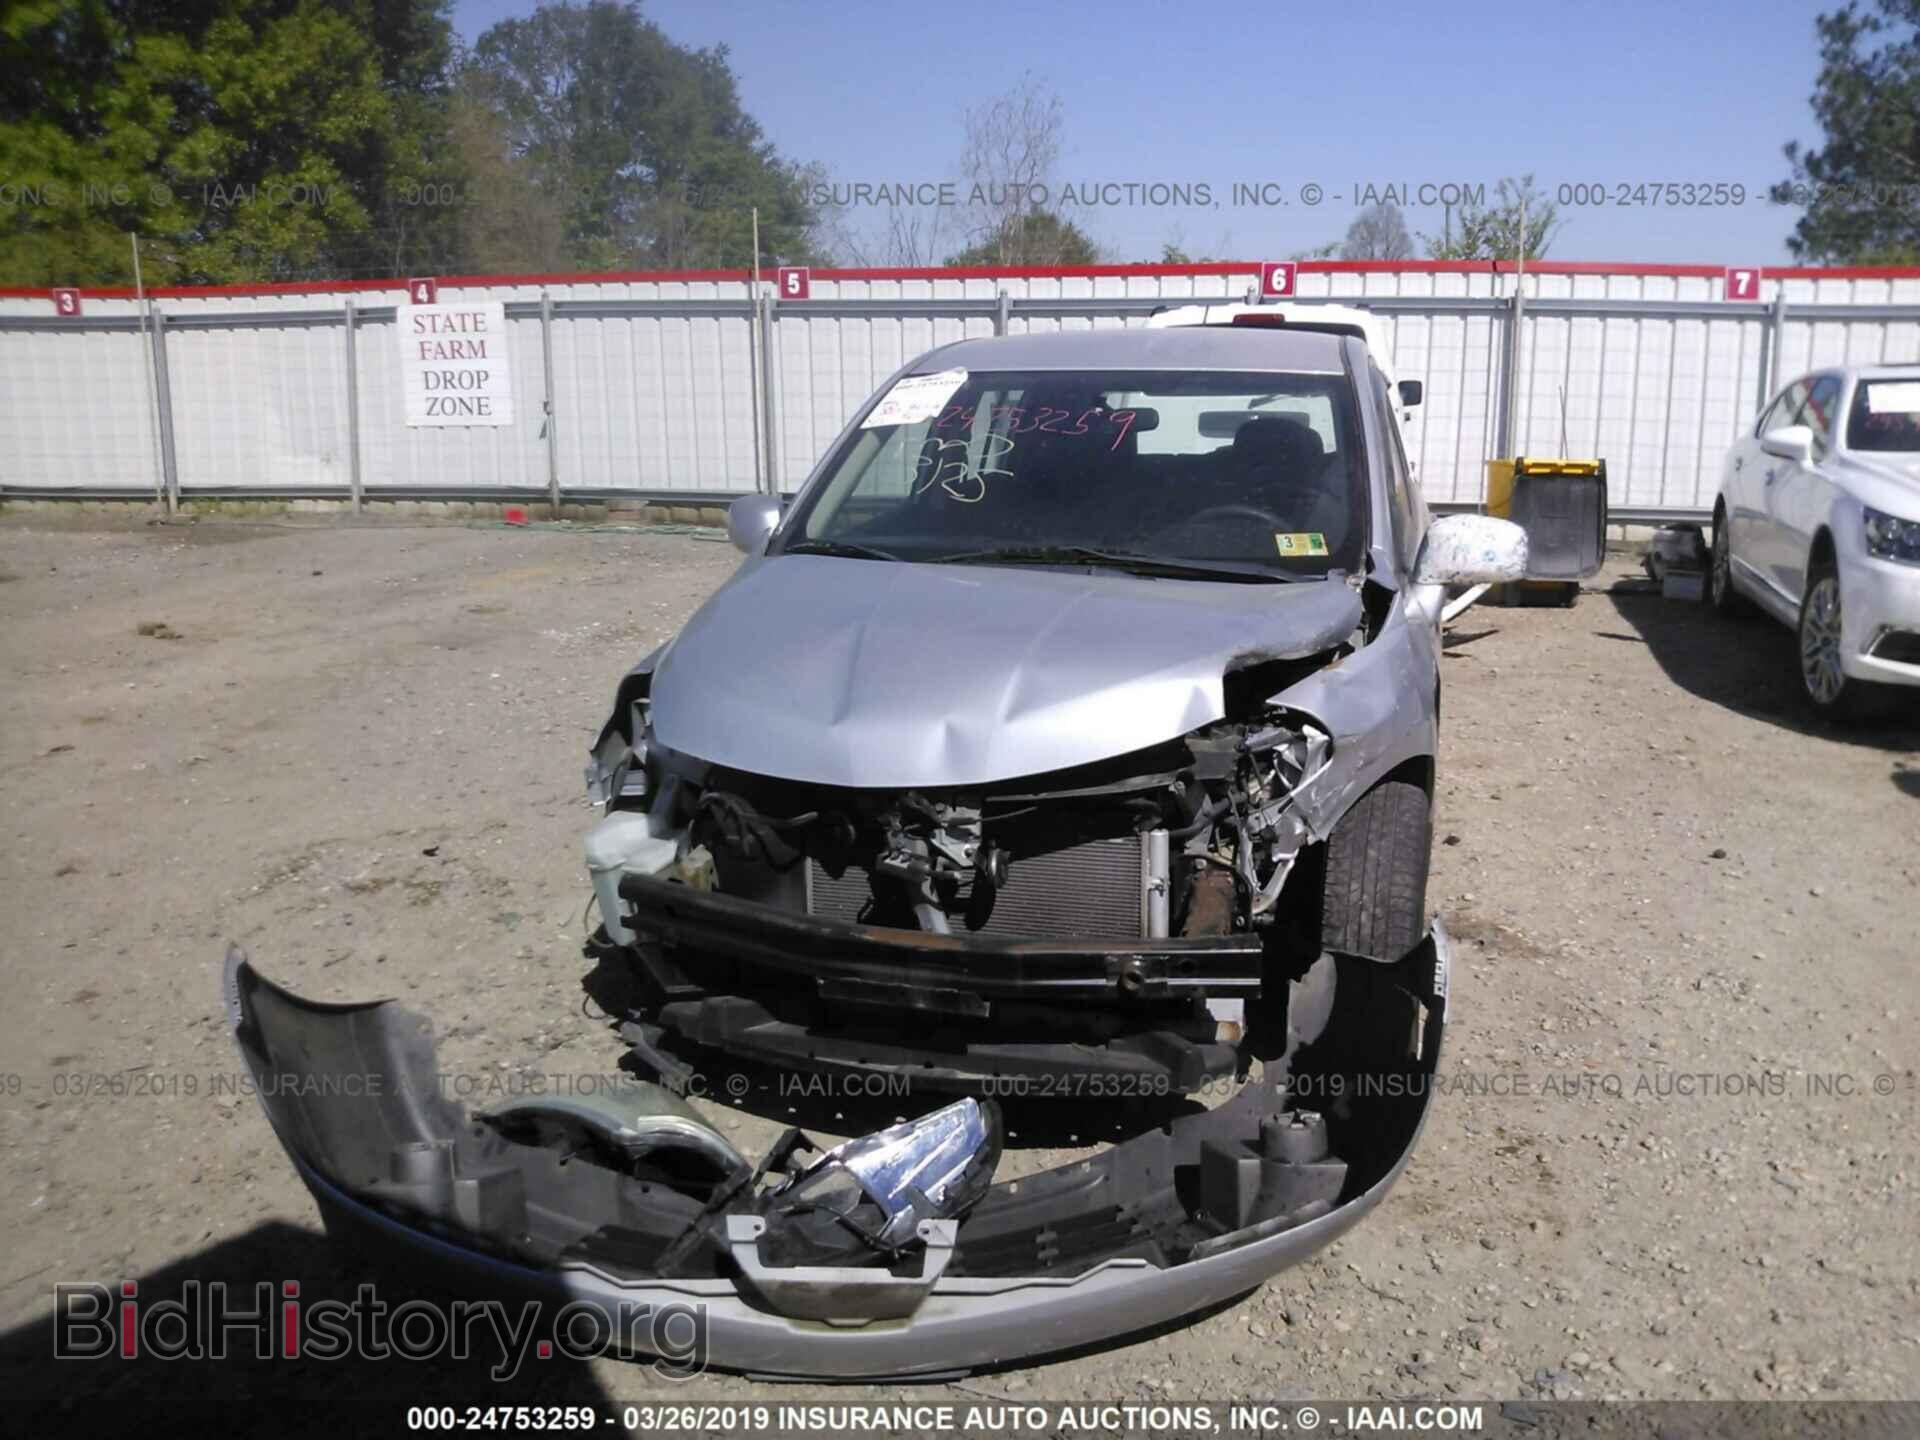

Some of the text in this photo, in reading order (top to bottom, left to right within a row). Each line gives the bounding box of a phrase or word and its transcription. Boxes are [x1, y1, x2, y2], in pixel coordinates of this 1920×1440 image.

[788, 272, 801, 294] 5
[1271, 267, 1287, 292] 6
[1735, 271, 1751, 295] 7
[61, 293, 74, 312] 3
[416, 283, 429, 302] 4
[413, 312, 488, 334] STATE
[418, 339, 487, 360] FARM
[423, 369, 490, 391] DROP
[425, 396, 492, 416] ZONE
